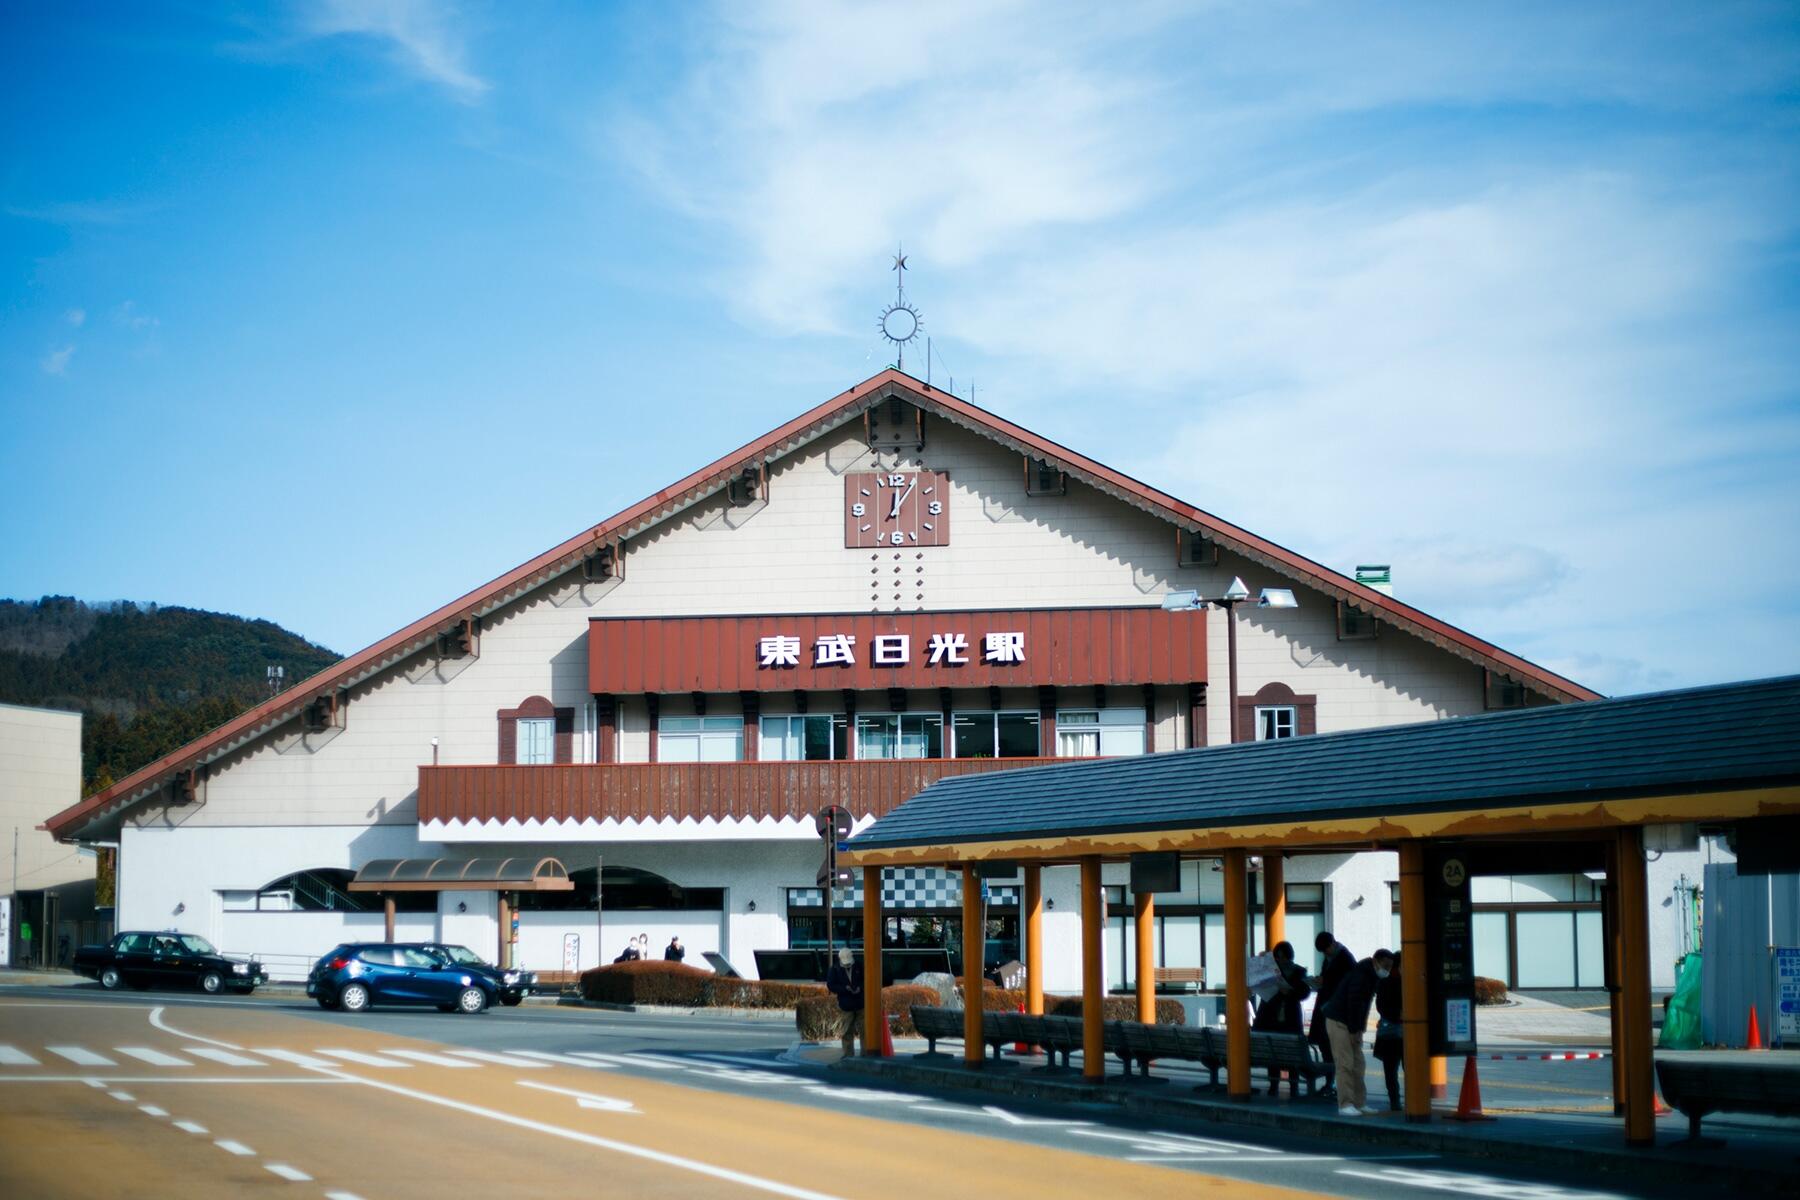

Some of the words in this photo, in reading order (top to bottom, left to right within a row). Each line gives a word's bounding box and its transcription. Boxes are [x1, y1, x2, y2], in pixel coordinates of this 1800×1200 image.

[888, 474, 906, 487] 12
[852, 504, 866, 518] 9
[929, 501, 943, 515] 3
[890, 531, 904, 545] 6
[759, 631, 1026, 665] 東武日光駅
[1446, 865, 1462, 878] 2A
